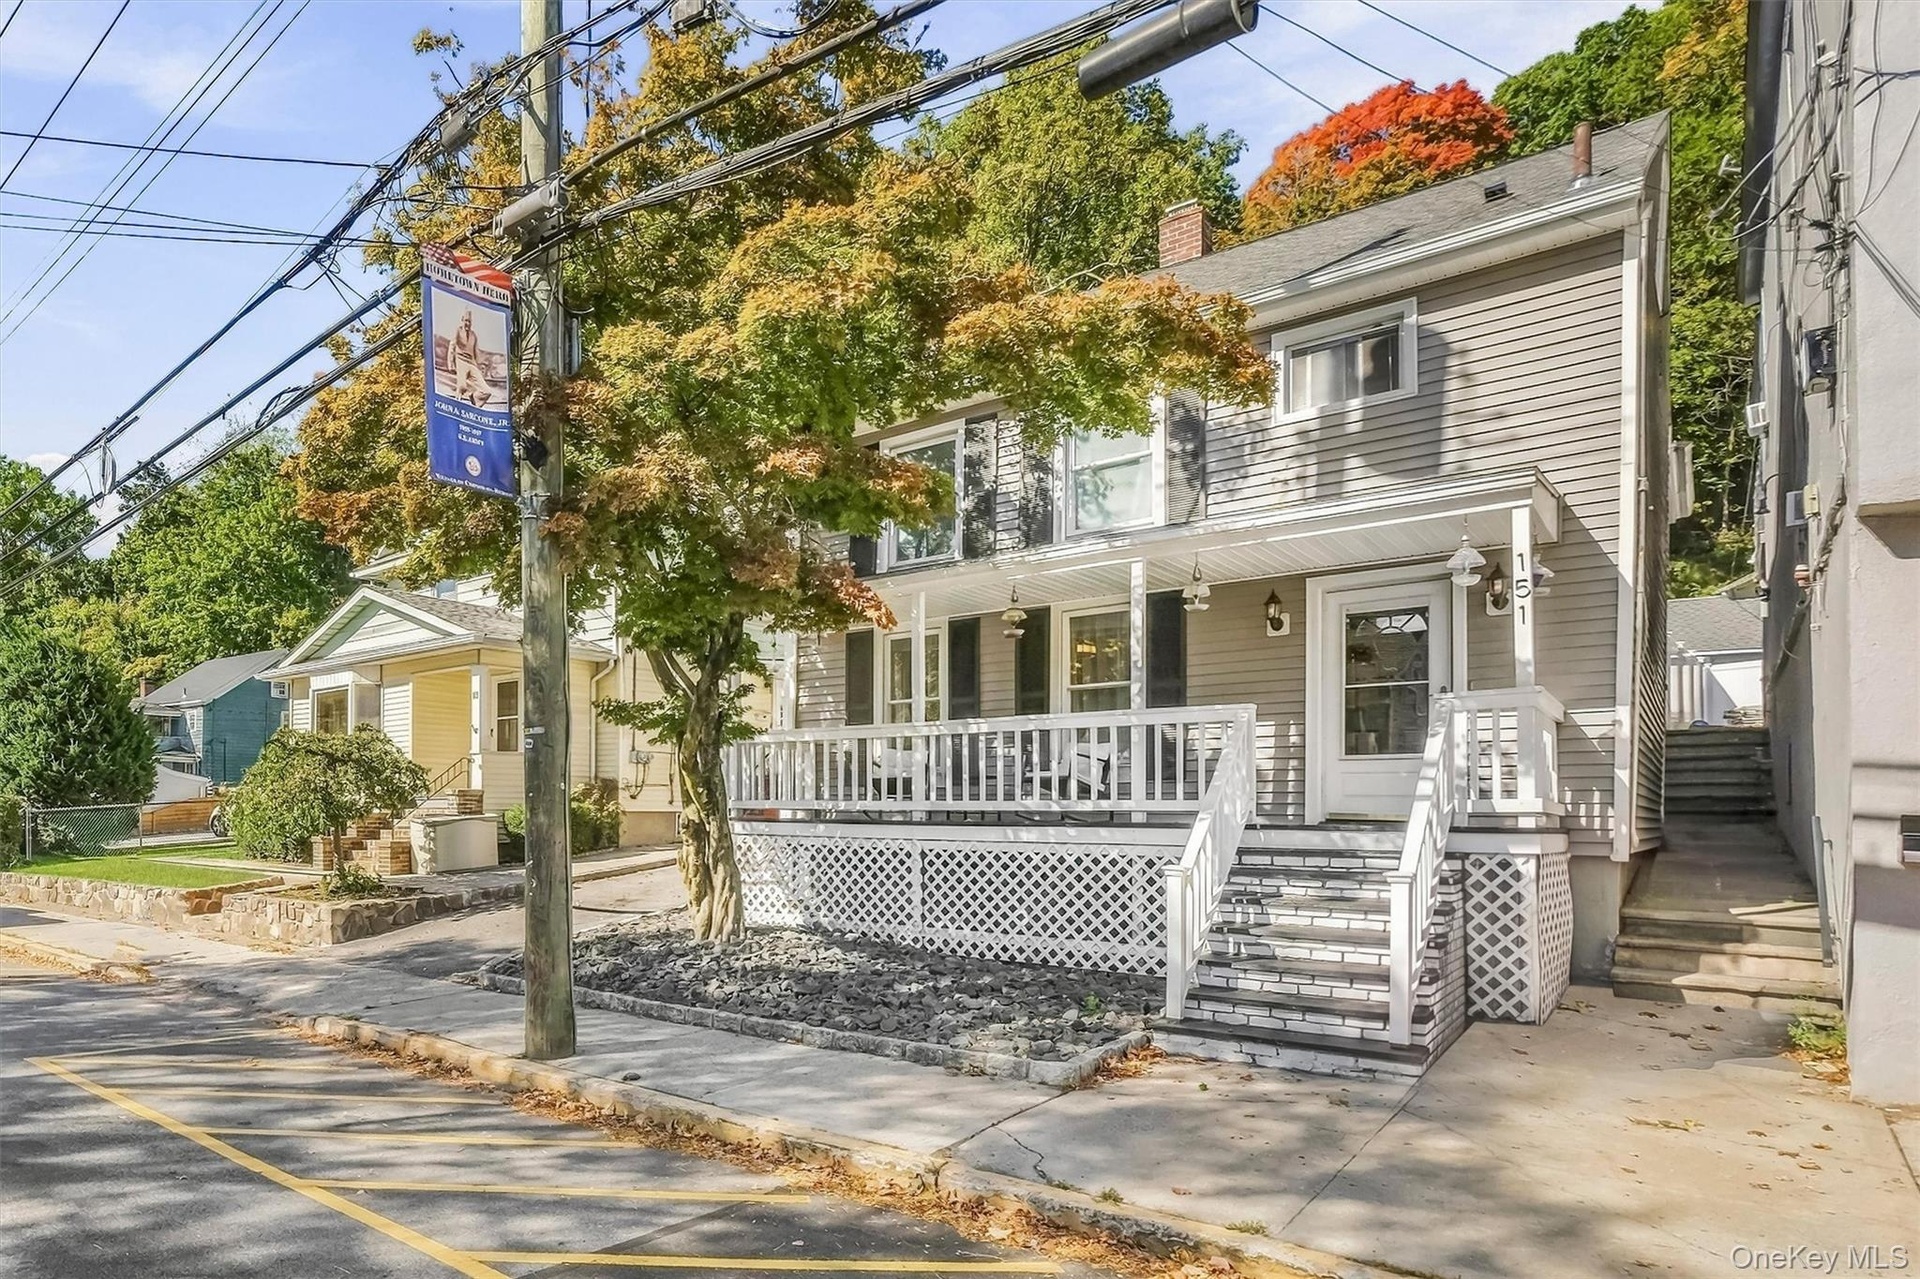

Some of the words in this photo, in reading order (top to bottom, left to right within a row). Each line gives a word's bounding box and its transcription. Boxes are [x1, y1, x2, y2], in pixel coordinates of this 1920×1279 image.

[426, 262, 479, 292] HOMETOWN
[434, 400, 453, 413] JOHN
[1515, 552, 1532, 625] 151
